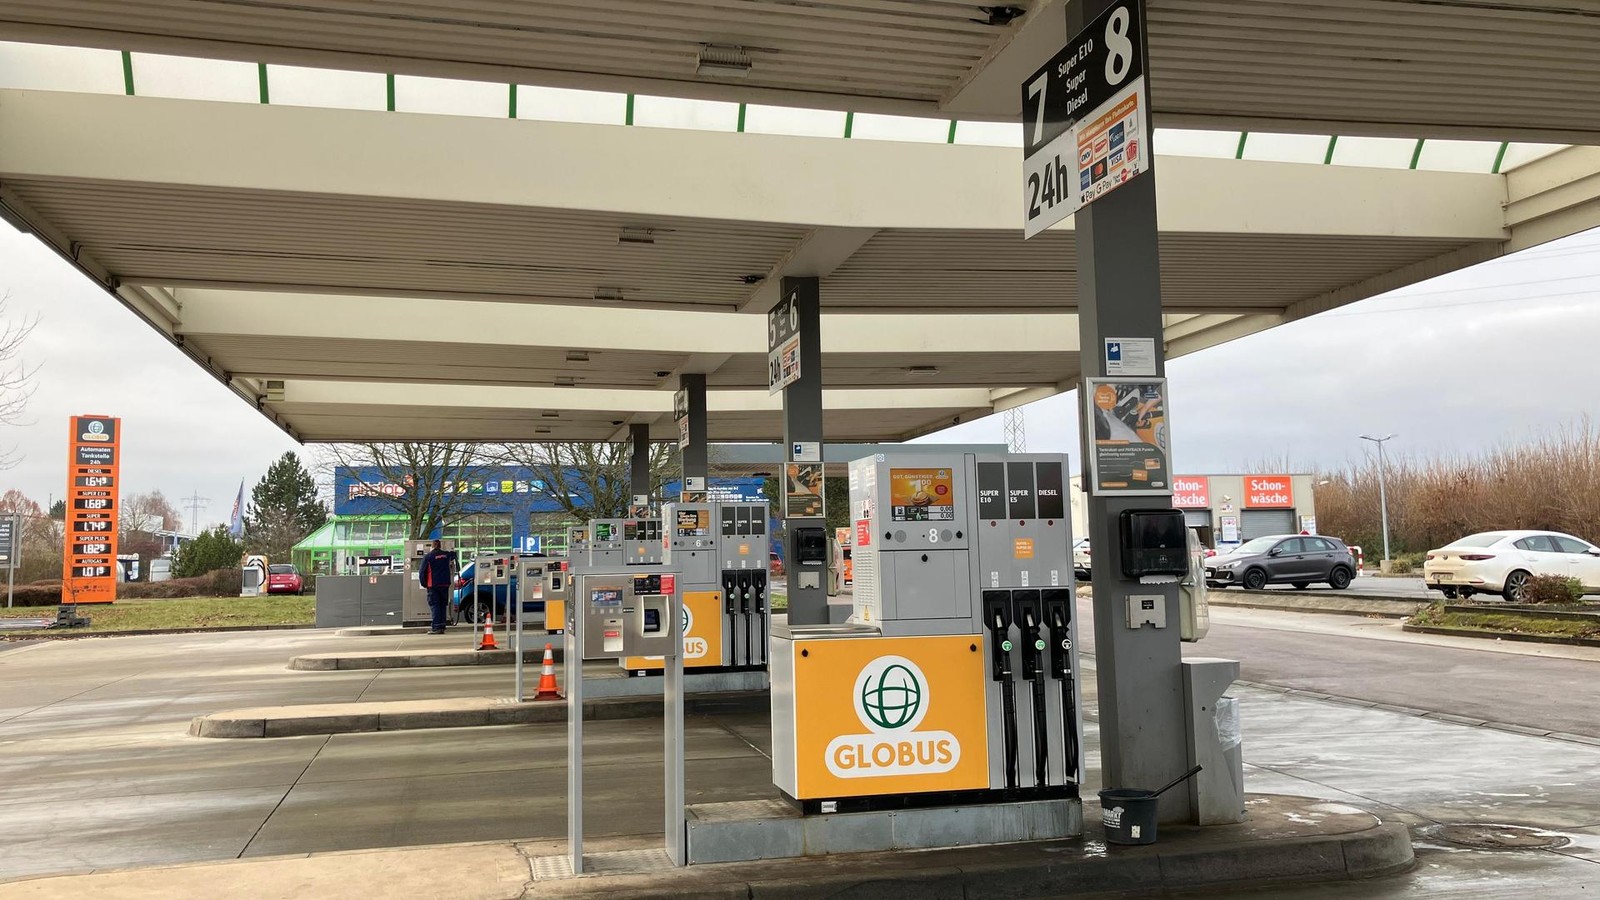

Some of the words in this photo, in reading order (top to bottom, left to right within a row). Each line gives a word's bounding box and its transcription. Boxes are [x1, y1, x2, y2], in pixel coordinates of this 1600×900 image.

[1058, 53, 1078, 78] Super
[1079, 38, 1093, 61] E10
[1104, 6, 1133, 86] 8
[1066, 69, 1086, 94] Super
[1028, 71, 1048, 146] 7
[1066, 87, 1088, 115] Diesel
[1111, 154, 1122, 167] VISA
[1028, 154, 1069, 221] 24h
[790, 292, 798, 331] 6
[769, 311, 776, 347] 5
[770, 356, 781, 386] 24h
[1173, 480, 1203, 491] chon-
[1251, 479, 1286, 491] Schon-
[1172, 493, 1205, 505] äsche
[1250, 493, 1288, 504] wäsche
[526, 537, 536, 550] P
[695, 539, 702, 547] 6
[928, 528, 939, 543] 8
[833, 739, 953, 770] GLOBUS
